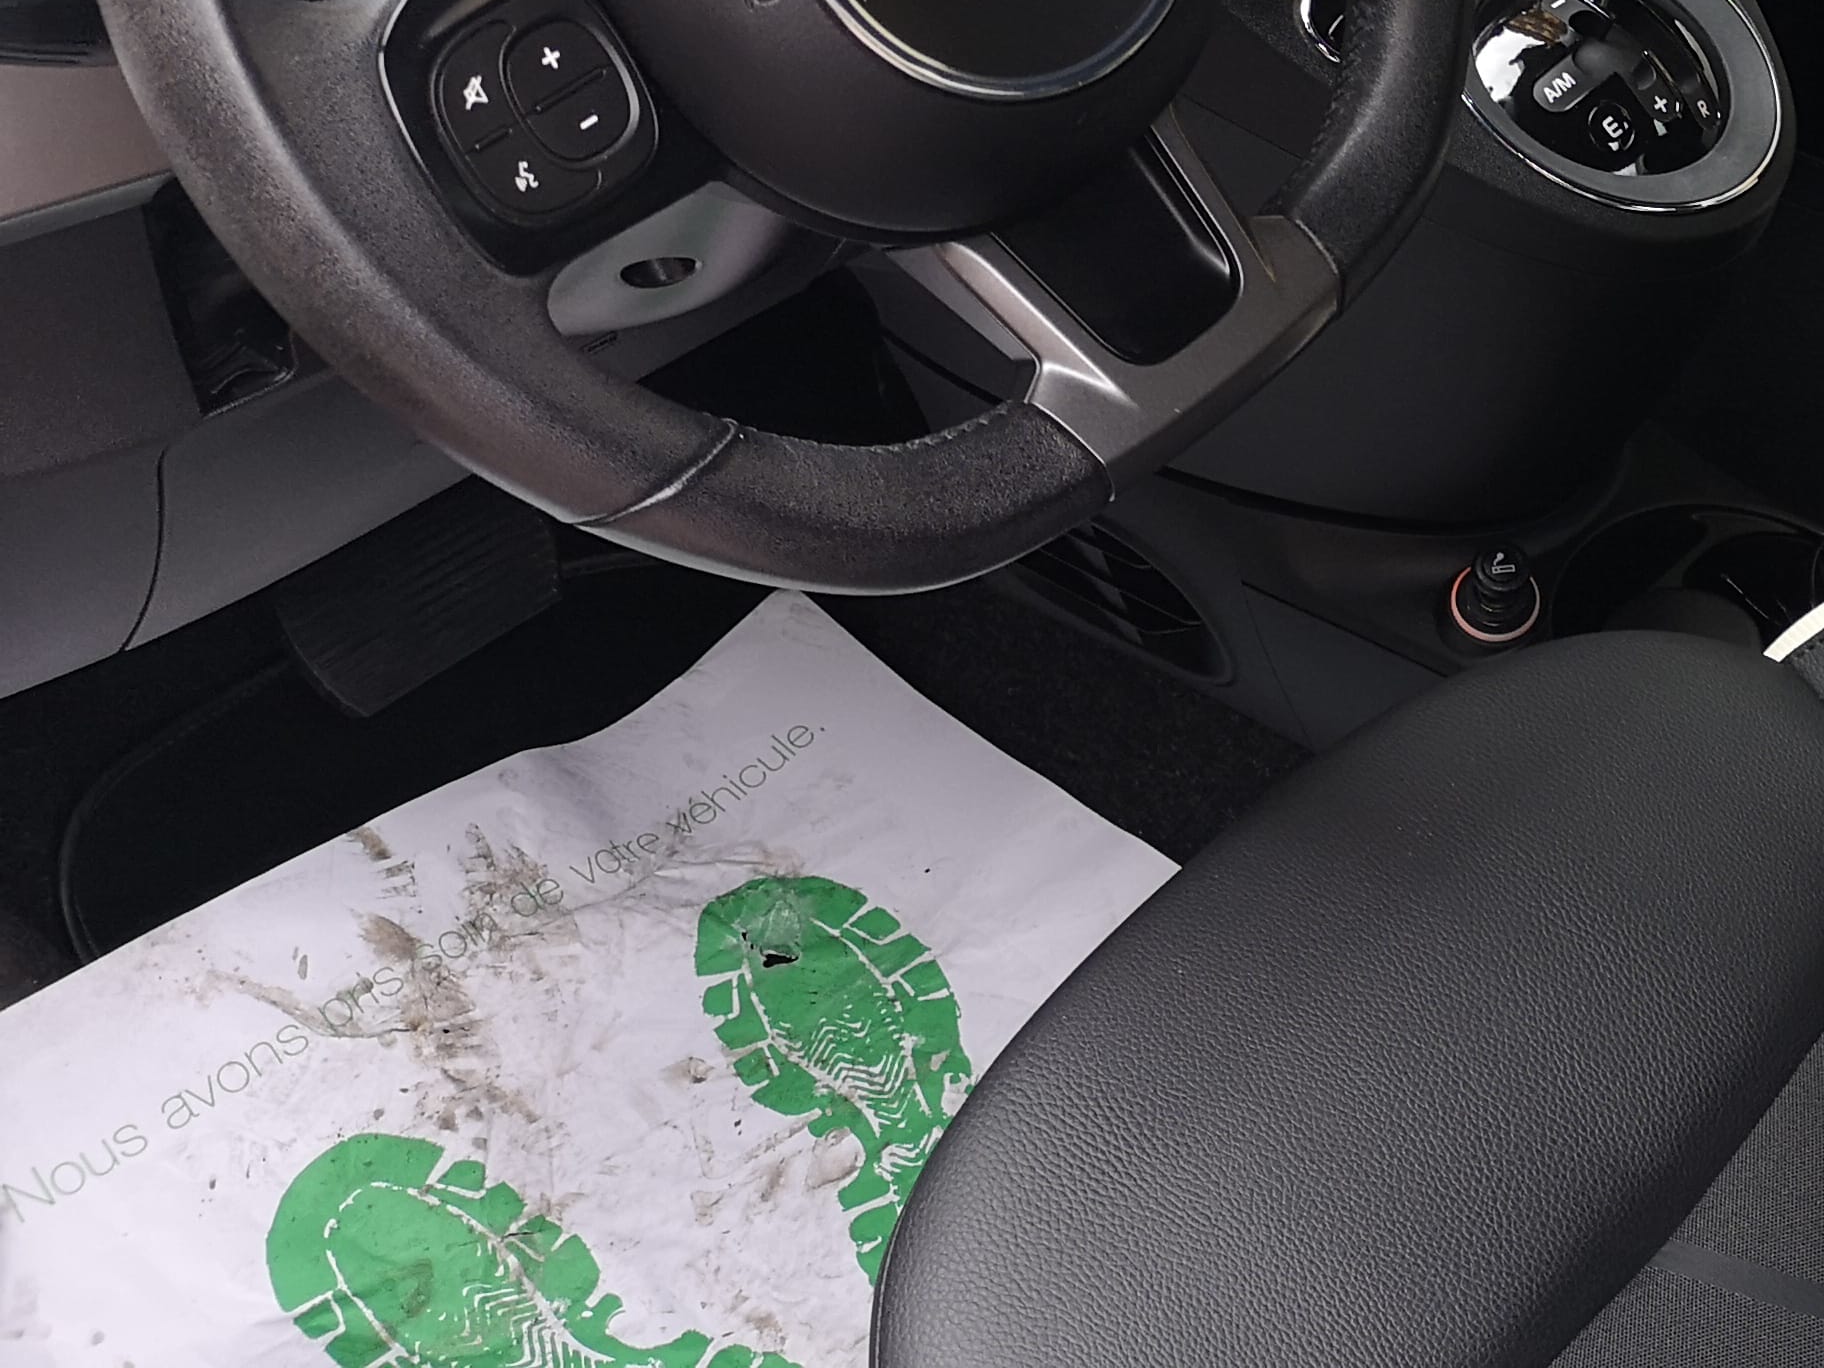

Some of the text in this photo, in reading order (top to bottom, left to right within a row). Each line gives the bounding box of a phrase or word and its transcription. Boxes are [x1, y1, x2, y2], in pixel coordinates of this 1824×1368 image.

[1543, 72, 1577, 103] A/M
[1697, 100, 1711, 118] R
[1602, 115, 1624, 139] E
[2, 1124, 149, 1223] Nous
[161, 1024, 309, 1130] avons
[416, 912, 498, 972] soin
[510, 878, 564, 917] de
[569, 832, 660, 884] votre
[666, 725, 826, 834] véhicule.
